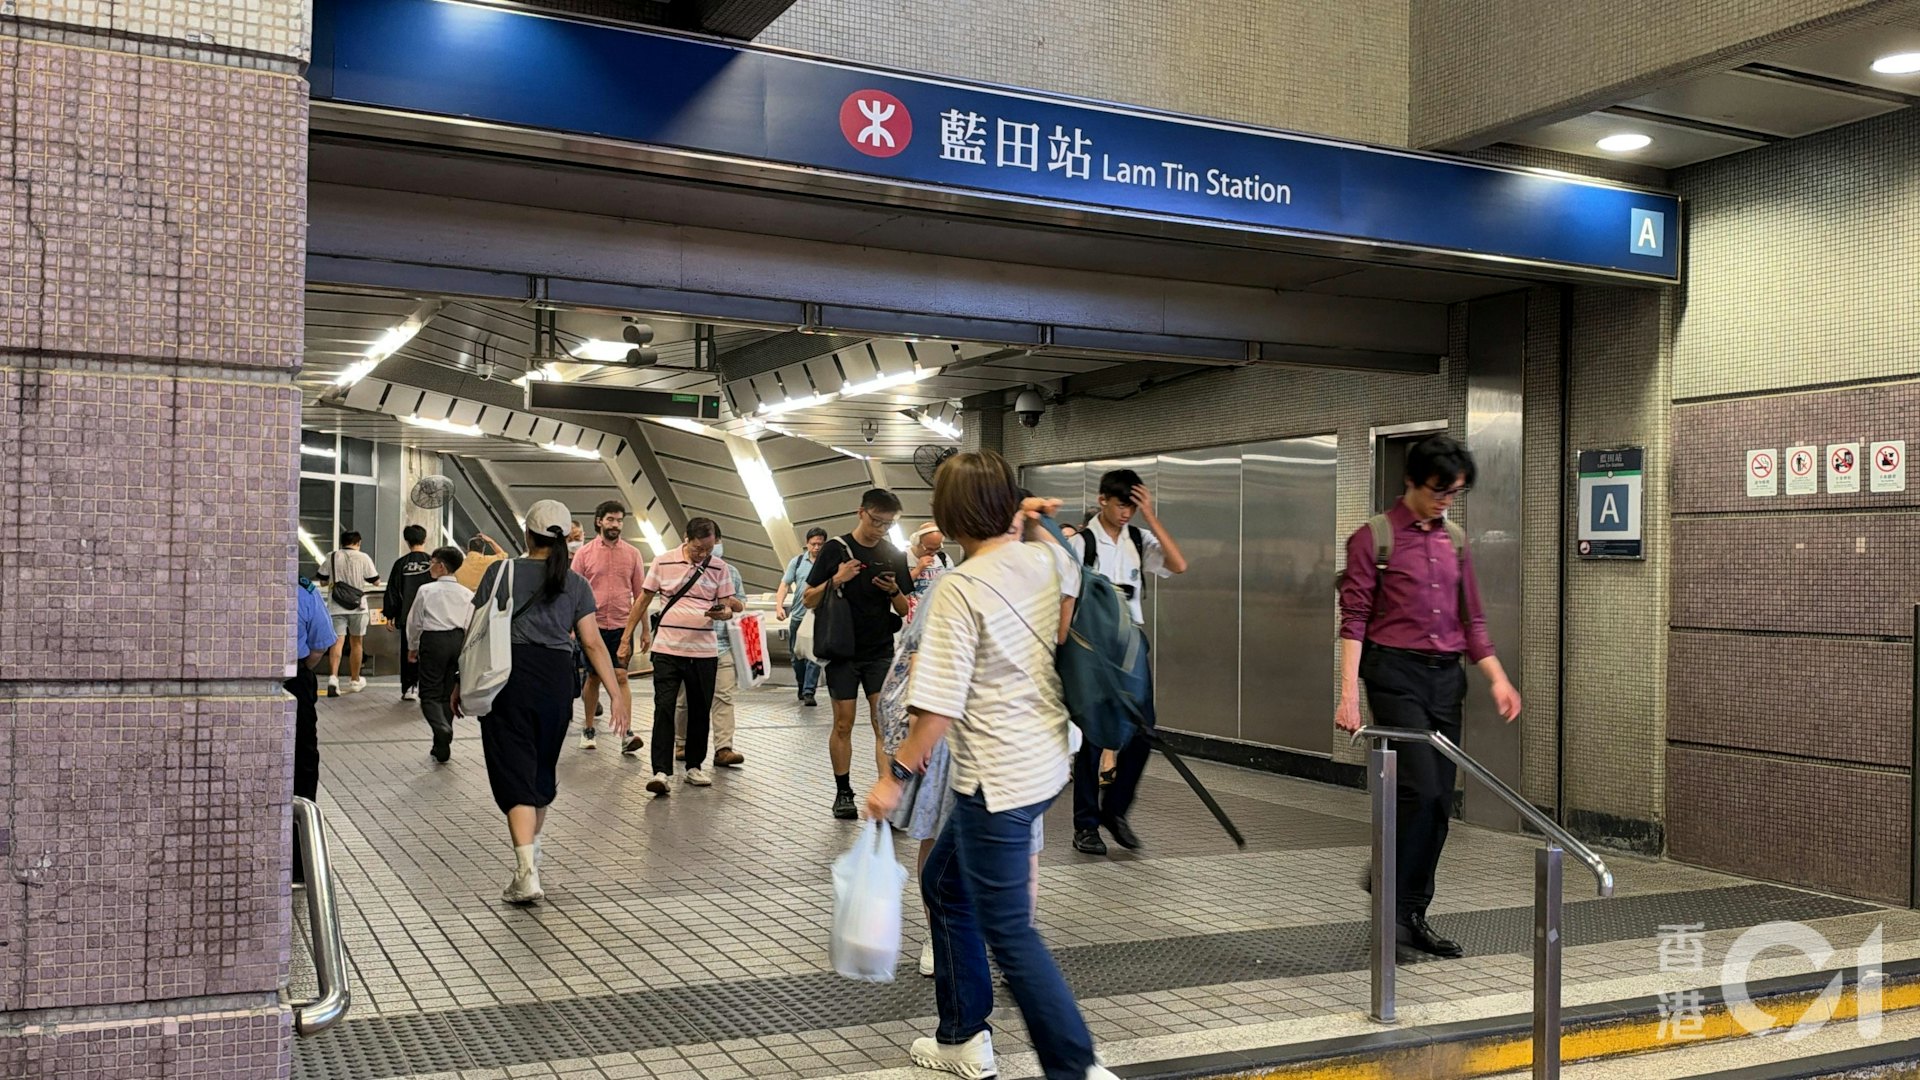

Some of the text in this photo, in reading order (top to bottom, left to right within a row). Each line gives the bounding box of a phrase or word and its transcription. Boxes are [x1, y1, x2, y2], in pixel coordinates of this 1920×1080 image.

[939, 107, 1291, 205] 藍田站 Lam Tin Station
[1638, 217, 1656, 249] A
[1599, 493, 1621, 524] A
